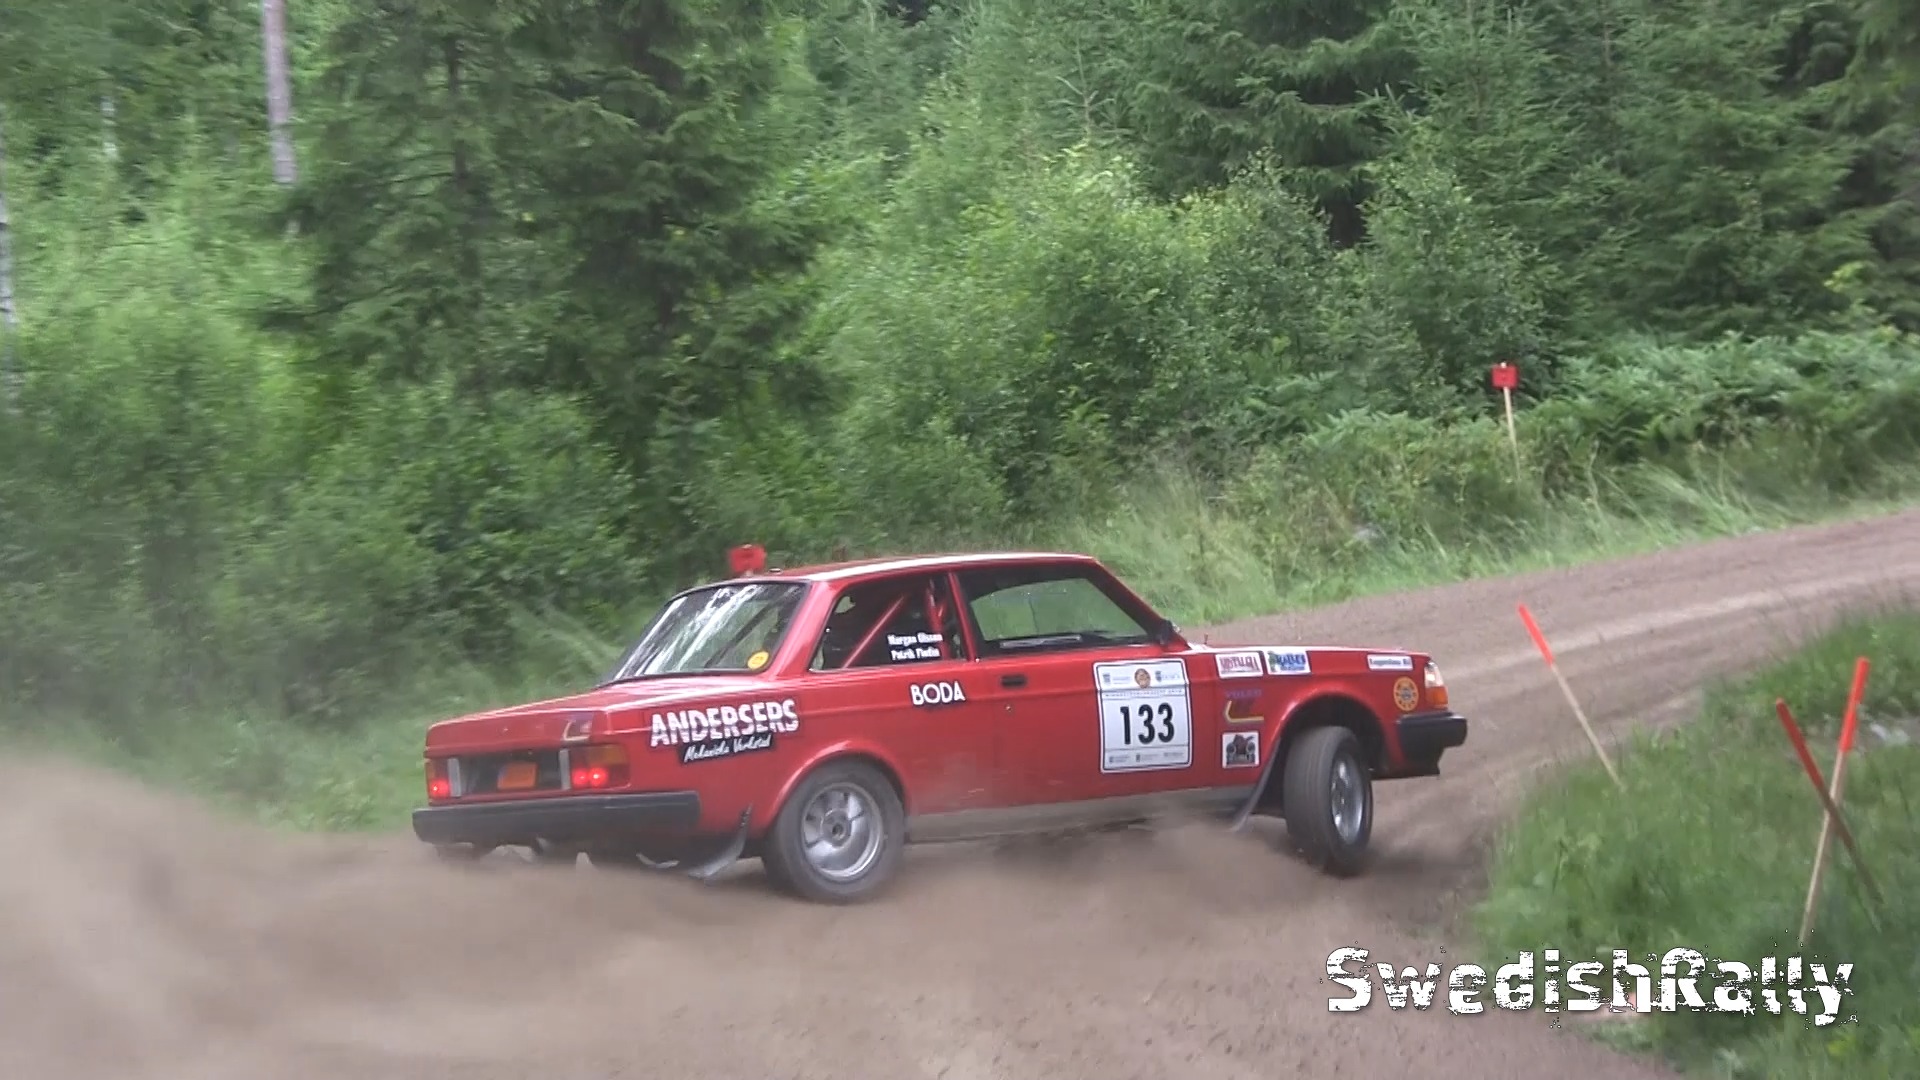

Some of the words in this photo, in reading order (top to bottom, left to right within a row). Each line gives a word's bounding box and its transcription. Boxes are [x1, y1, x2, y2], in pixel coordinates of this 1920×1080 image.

[910, 681, 966, 707] BODA
[650, 698, 799, 747] ANDERSERS
[1119, 702, 1176, 745] 133
